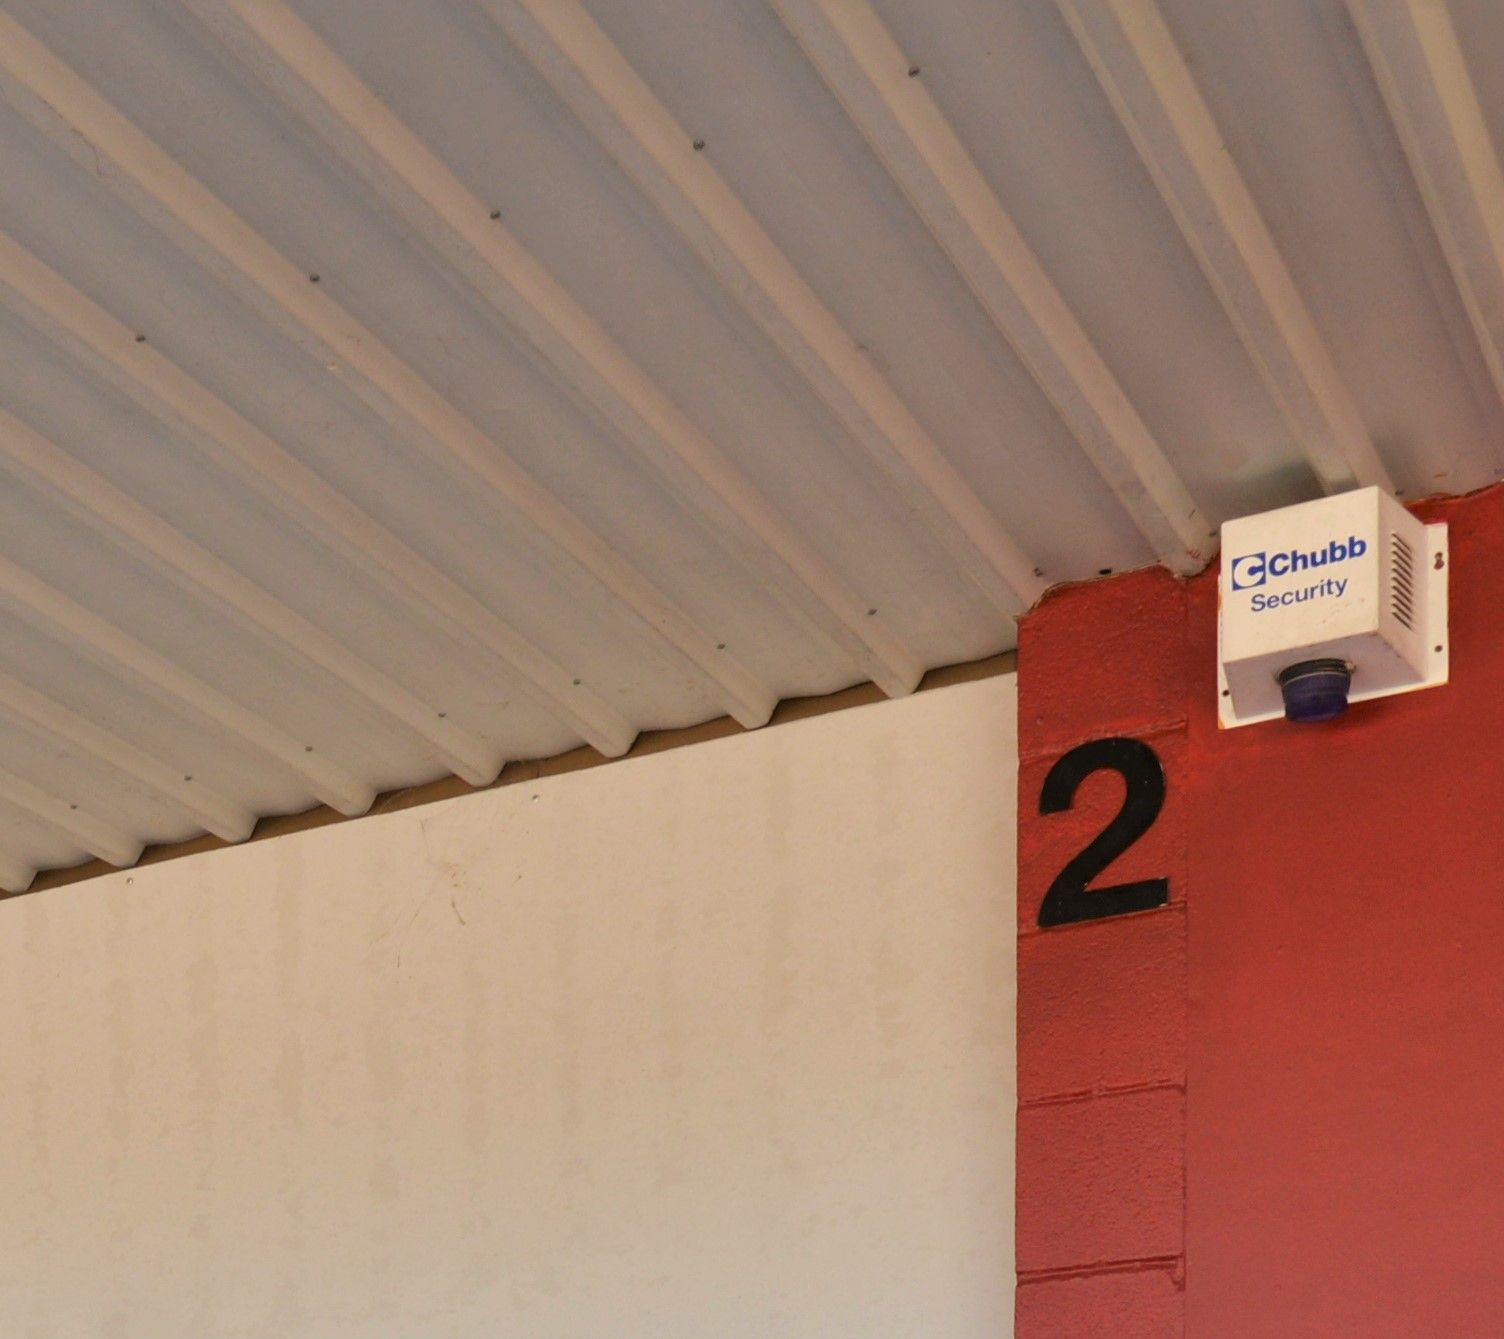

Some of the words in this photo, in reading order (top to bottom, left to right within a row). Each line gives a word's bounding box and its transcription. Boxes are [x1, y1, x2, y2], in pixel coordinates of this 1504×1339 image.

[1268, 536, 1367, 577] Chubb
[1250, 577, 1348, 612] Security
[1038, 737, 1169, 928] 2
